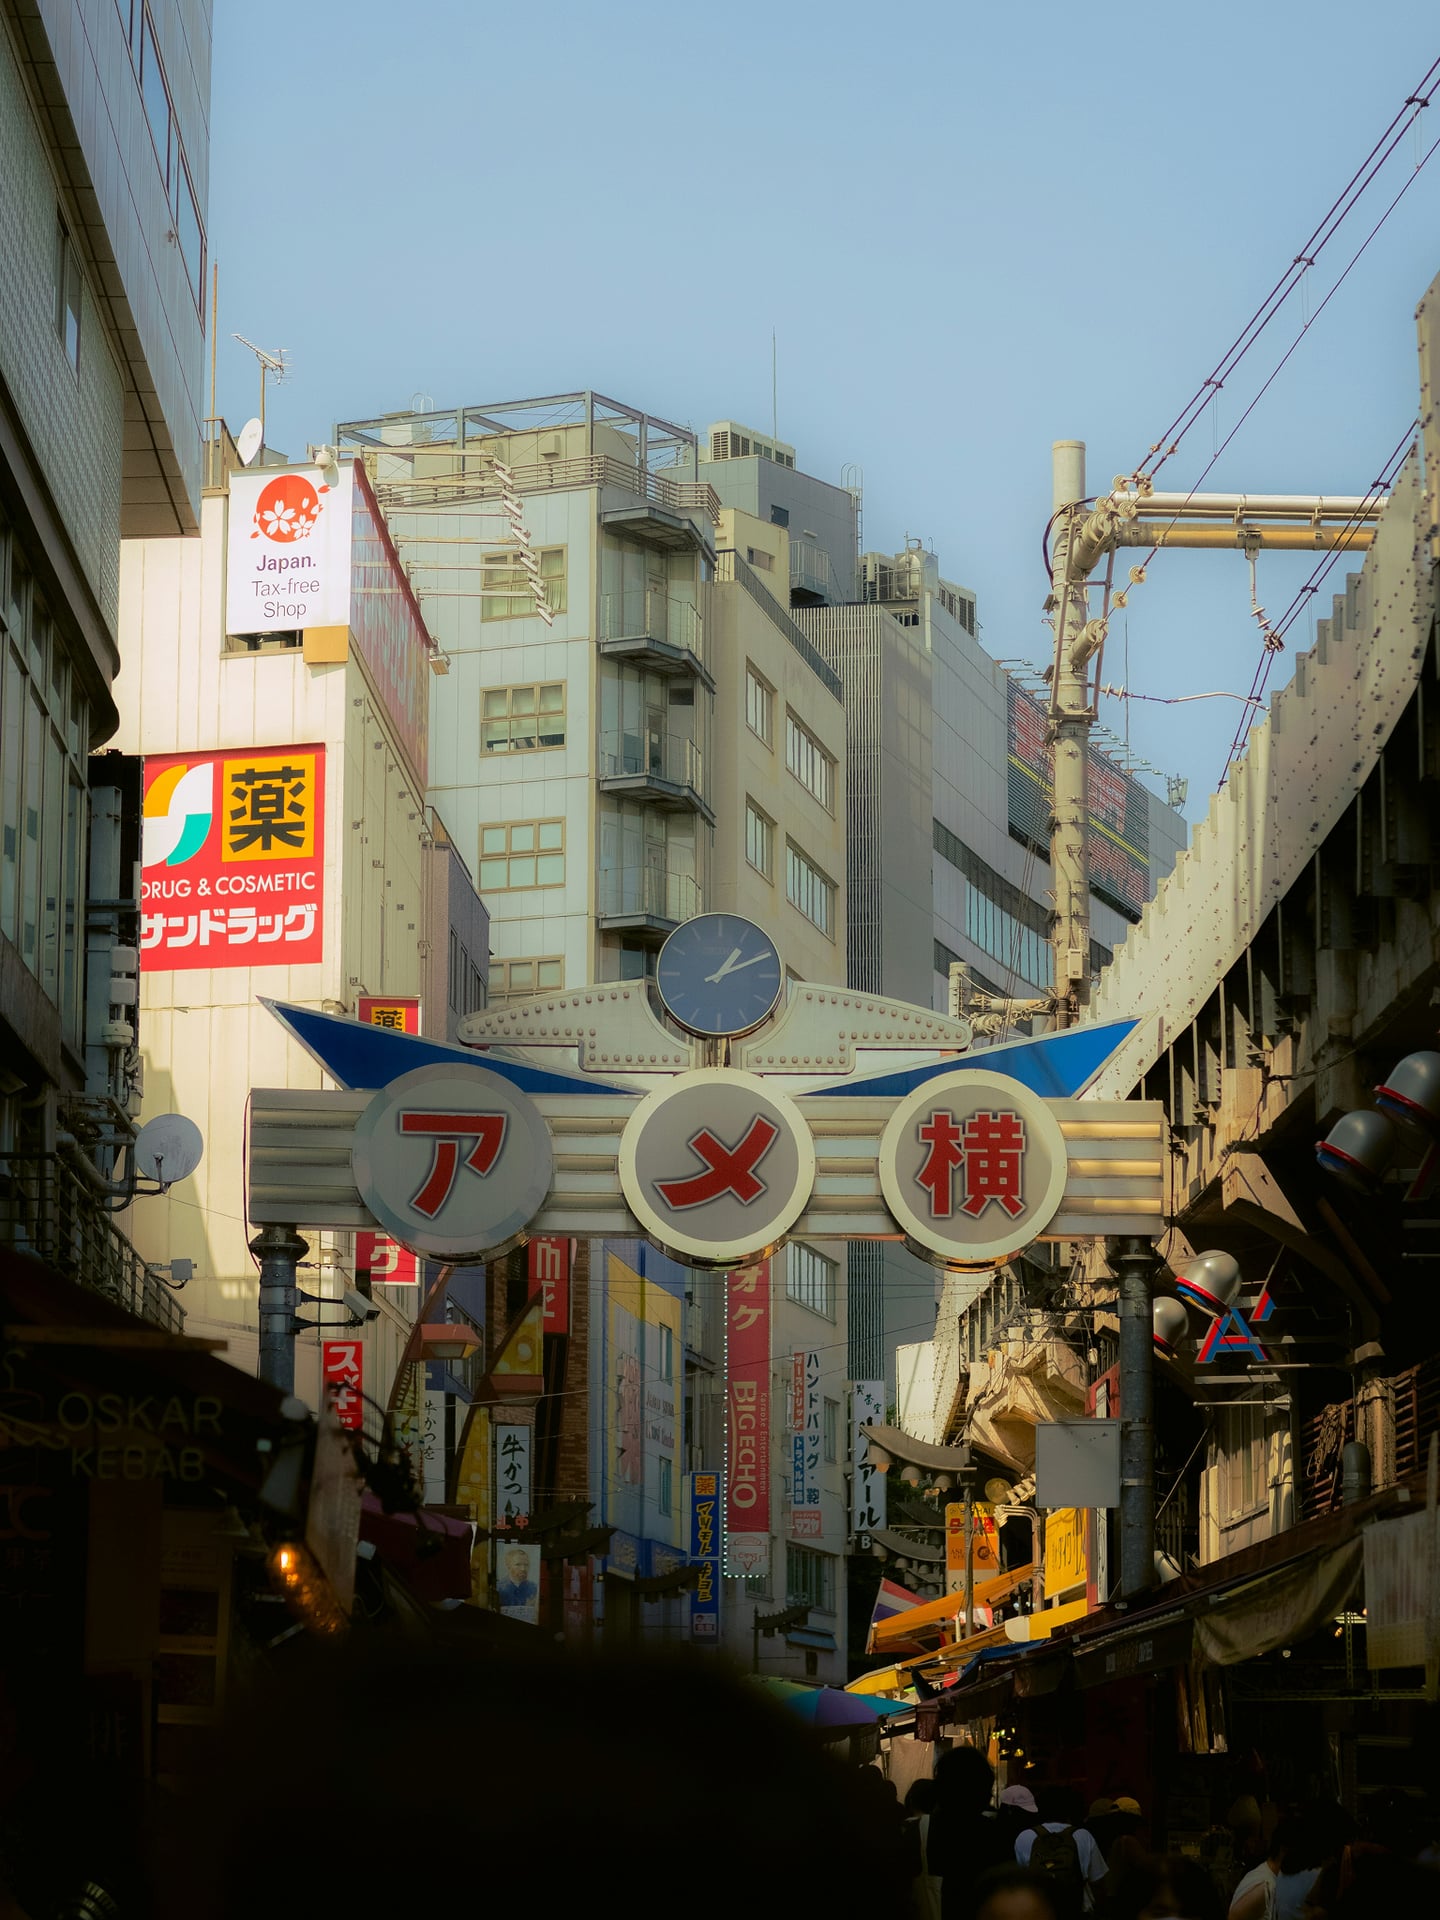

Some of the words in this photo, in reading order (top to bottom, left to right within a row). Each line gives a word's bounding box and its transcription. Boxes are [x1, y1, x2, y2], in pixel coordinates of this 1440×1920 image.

[251, 578, 320, 596] Tax-free
[256, 554, 317, 574] Japan.
[263, 600, 307, 620] Shop
[229, 765, 306, 854] 薬
[141, 877, 192, 900] DRUG
[197, 876, 212, 896] &
[215, 871, 316, 896] COSMETIC
[140, 903, 318, 949] サンドラッグ
[399, 1110, 1027, 1222] アメ横
[370, 1233, 401, 1274] グ
[731, 1265, 765, 1331] オケ
[56, 1390, 225, 1436] OSKAR
[732, 1380, 758, 1431] BIG
[759, 1391, 768, 1433] Karaoke
[70, 1445, 207, 1482] KEBAB
[732, 1437, 758, 1509] ECHO
[759, 1435, 768, 1496] Entertainment
